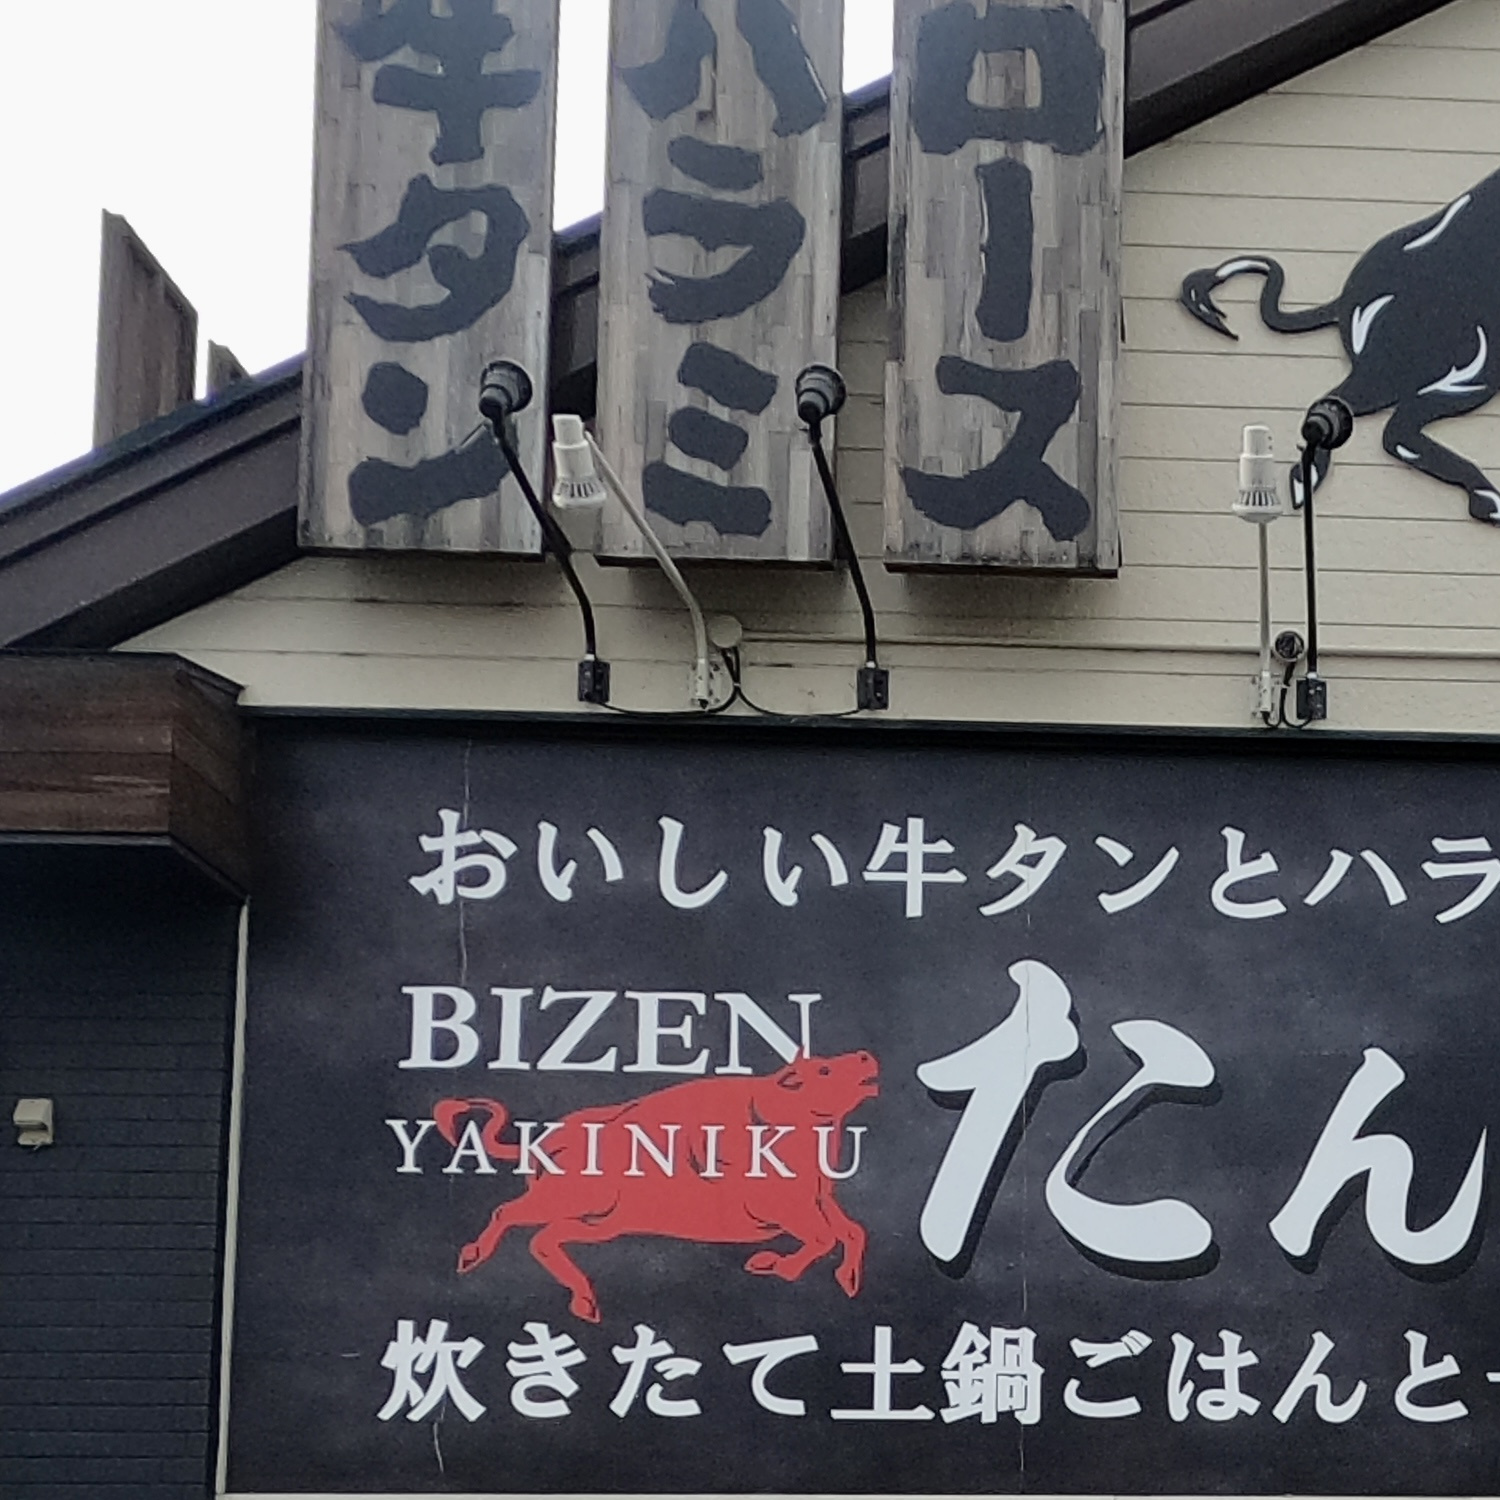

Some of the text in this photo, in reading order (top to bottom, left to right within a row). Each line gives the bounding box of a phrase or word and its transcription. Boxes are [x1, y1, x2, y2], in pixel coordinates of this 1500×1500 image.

[897, 2, 1105, 542] ロース
[397, 984, 822, 1075] BIZEN
[385, 1118, 868, 1180] YAKINIKU
